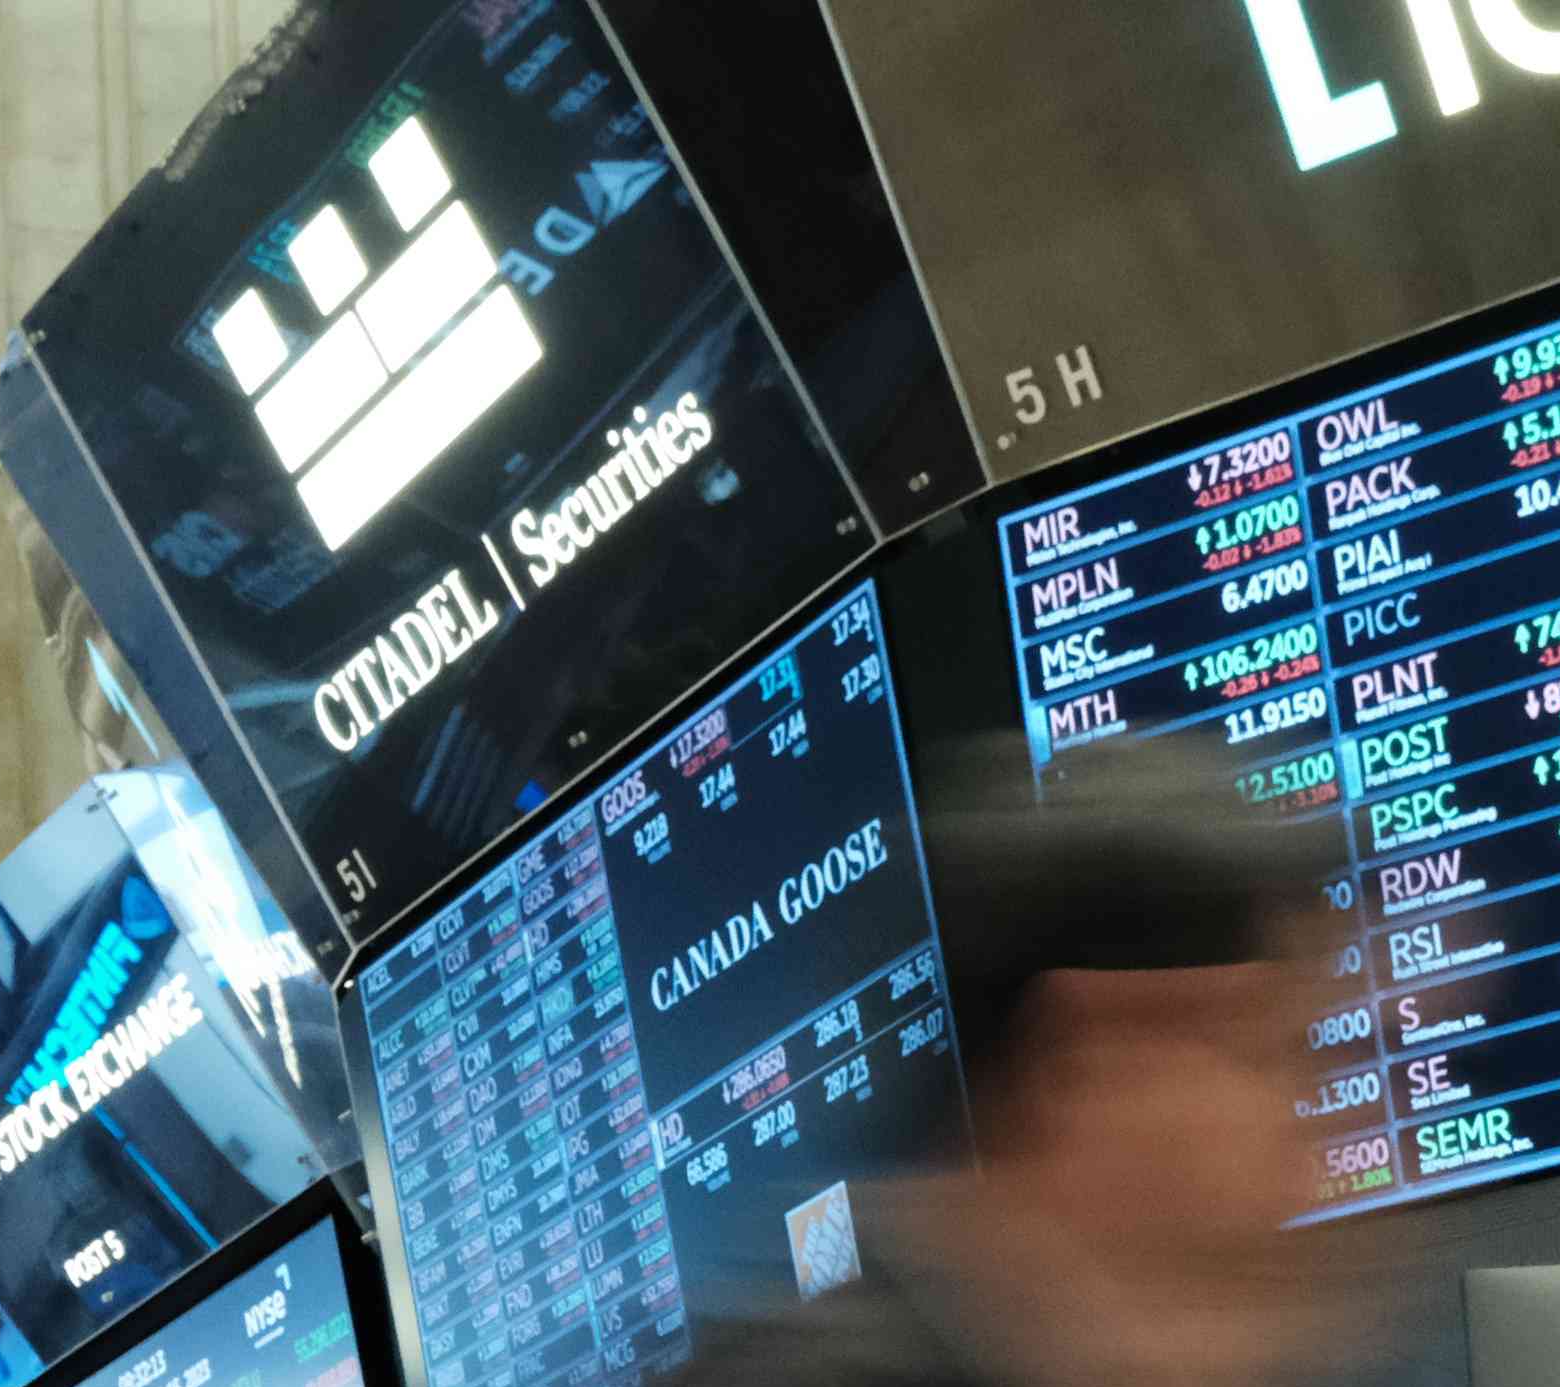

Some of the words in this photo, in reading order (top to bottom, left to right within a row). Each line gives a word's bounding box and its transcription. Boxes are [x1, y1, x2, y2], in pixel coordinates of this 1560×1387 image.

[1005, 365, 1046, 425] 5
[1055, 345, 1103, 405] H
[1317, 399, 1400, 449] OWL
[1204, 432, 1290, 484] 7.3200
[1325, 459, 1418, 513] PACK
[1023, 506, 1081, 552] MIR
[1213, 496, 1300, 548] 1.0700
[312, 568, 499, 752] CITADEL
[510, 392, 712, 588] Securities
[1334, 530, 1402, 579] PIAI
[1032, 559, 1121, 615] MPLN
[1221, 559, 1308, 612] 6.4700
[1344, 594, 1422, 646] PICC
[1041, 627, 1108, 677] MSC
[1352, 654, 1439, 706] PLNT
[1049, 690, 1118, 740] MTH
[1362, 718, 1449, 771] POST
[600, 770, 647, 823] GOOS
[1371, 785, 1459, 834] PSPC
[1380, 850, 1464, 903] RDW
[648, 900, 774, 1012] CANADA
[777, 818, 888, 925] GOOSE
[1389, 925, 1442, 966] RSI
[64, 971, 203, 1111] EXCHANGE
[1407, 1056, 1451, 1094] SE
[658, 1112, 685, 1150] HD
[1416, 1108, 1512, 1160] SEMR
[64, 1239, 110, 1288] POST
